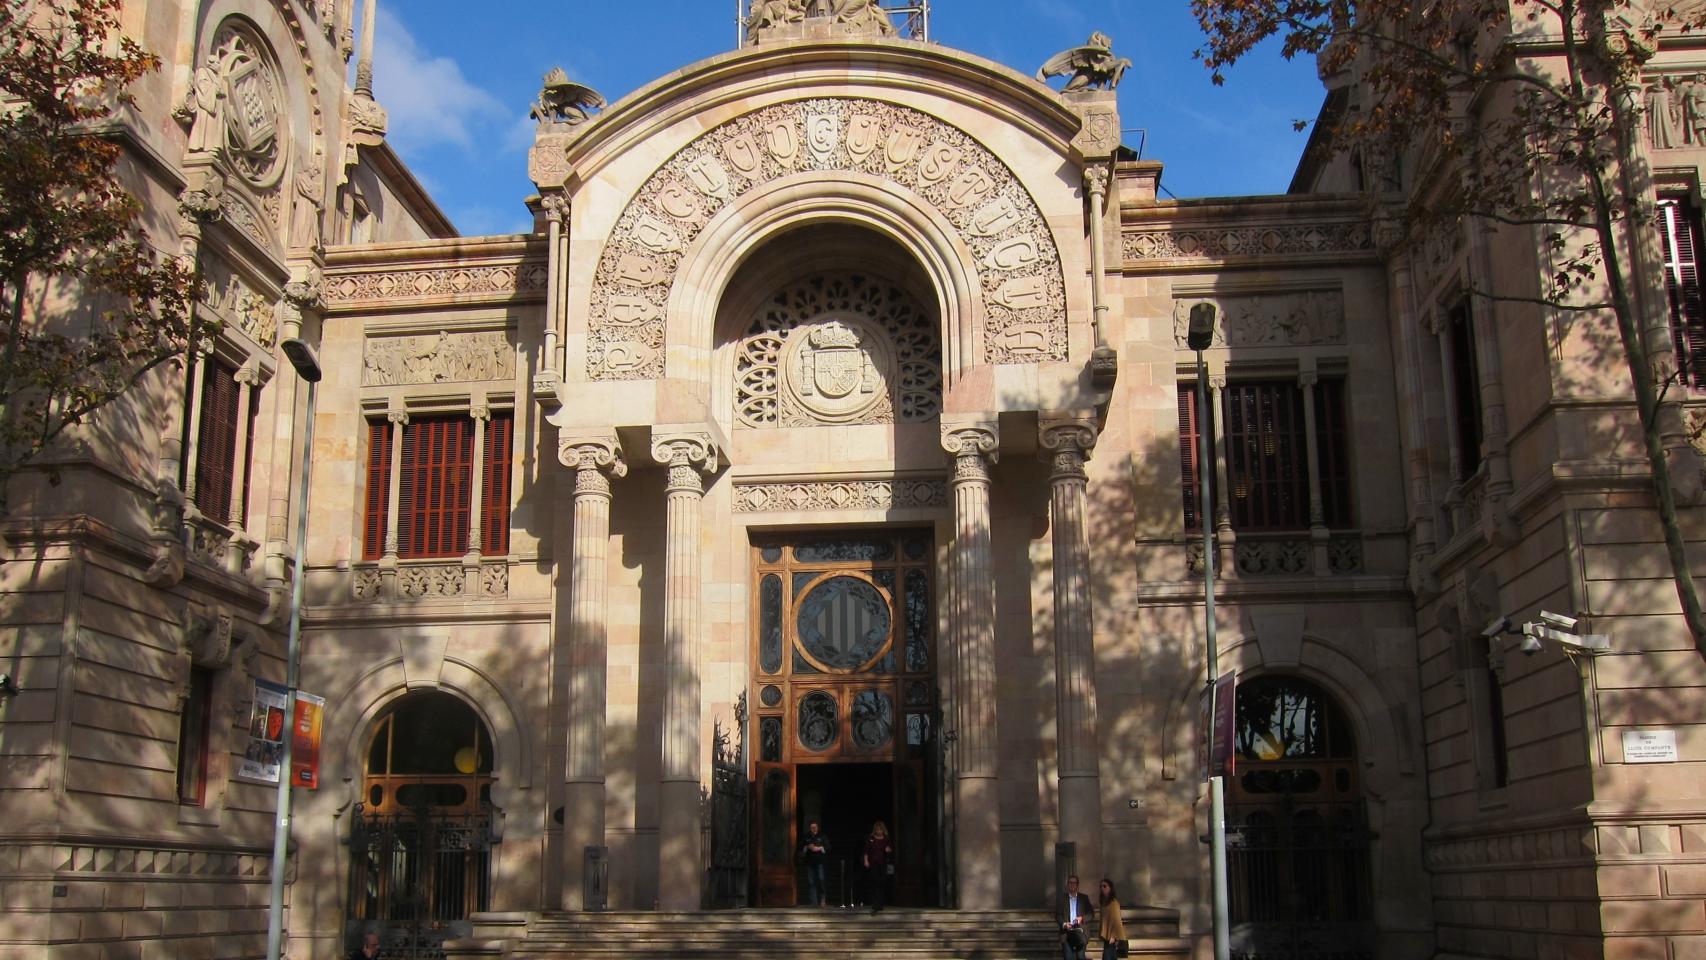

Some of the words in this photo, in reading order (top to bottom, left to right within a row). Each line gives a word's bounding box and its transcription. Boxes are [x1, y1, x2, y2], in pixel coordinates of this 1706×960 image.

[606, 138, 757, 369] PALACIO
[767, 118, 832, 159] DE
[849, 119, 1047, 352] JUSTICIA
